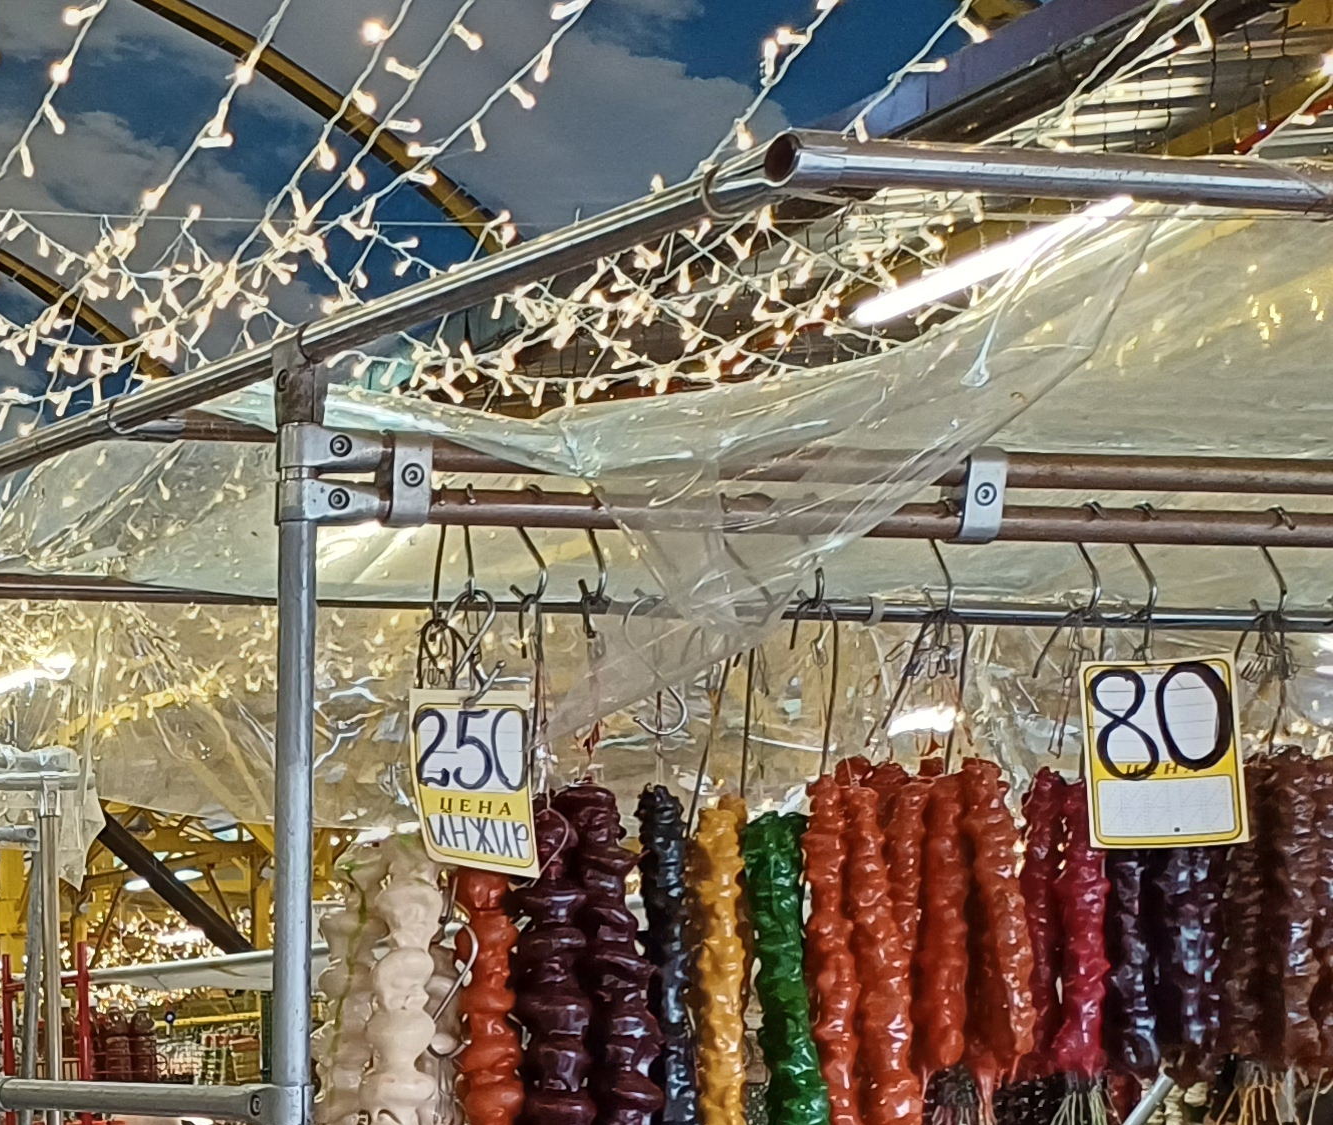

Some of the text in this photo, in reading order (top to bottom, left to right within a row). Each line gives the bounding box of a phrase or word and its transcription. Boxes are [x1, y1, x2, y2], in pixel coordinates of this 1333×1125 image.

[412, 708, 530, 790] 250
[1089, 662, 1232, 781] 80
[426, 814, 530, 859] ИНЖИР
[439, 797, 512, 816] ЦЕНА
